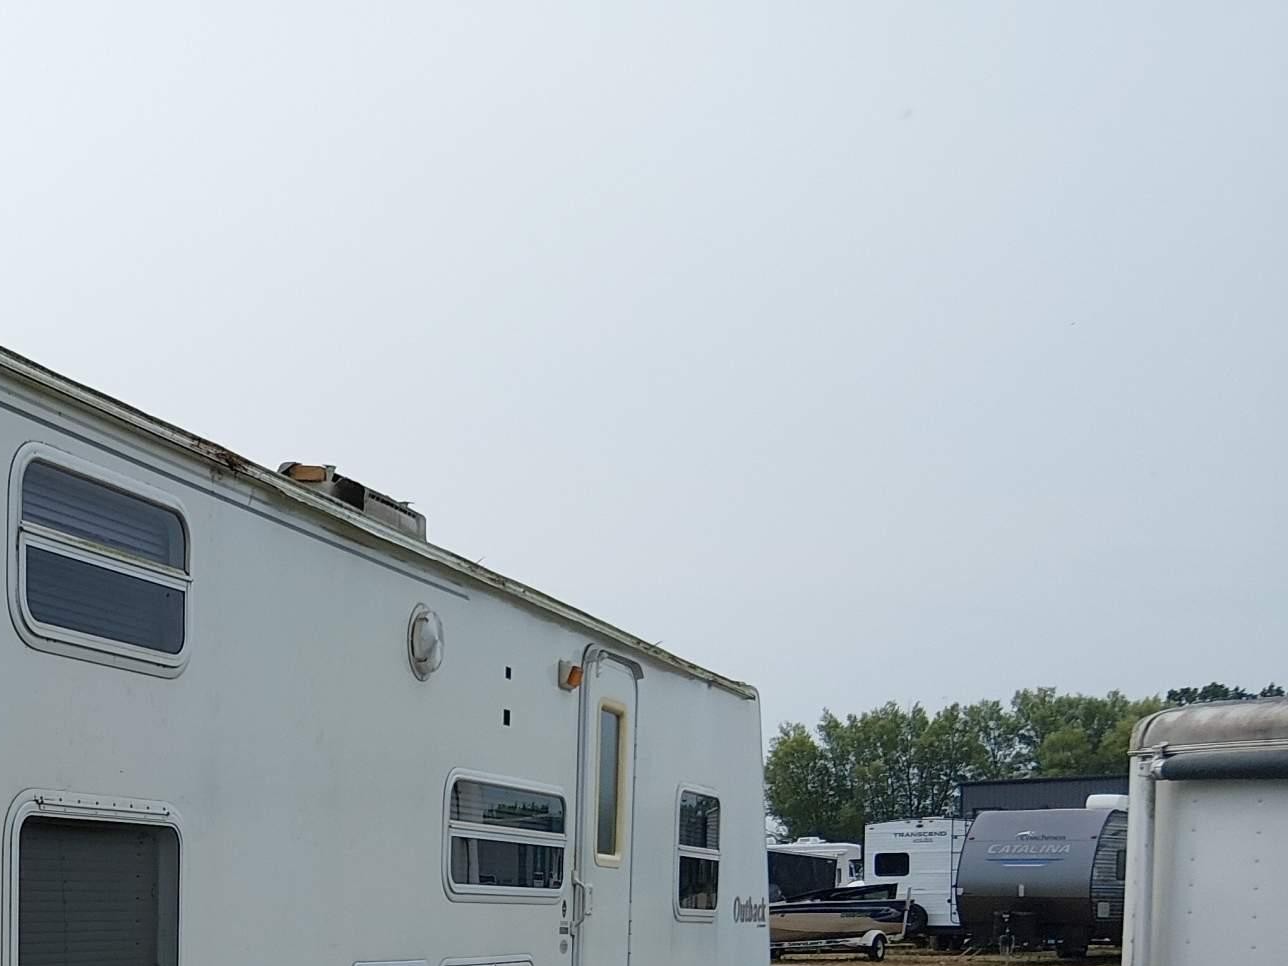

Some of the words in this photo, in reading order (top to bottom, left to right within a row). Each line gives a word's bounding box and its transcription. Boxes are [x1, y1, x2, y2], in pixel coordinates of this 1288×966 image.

[893, 830, 948, 838] TRANSCEND
[987, 843, 1071, 854] CATALINA
[733, 895, 767, 923] Outback
